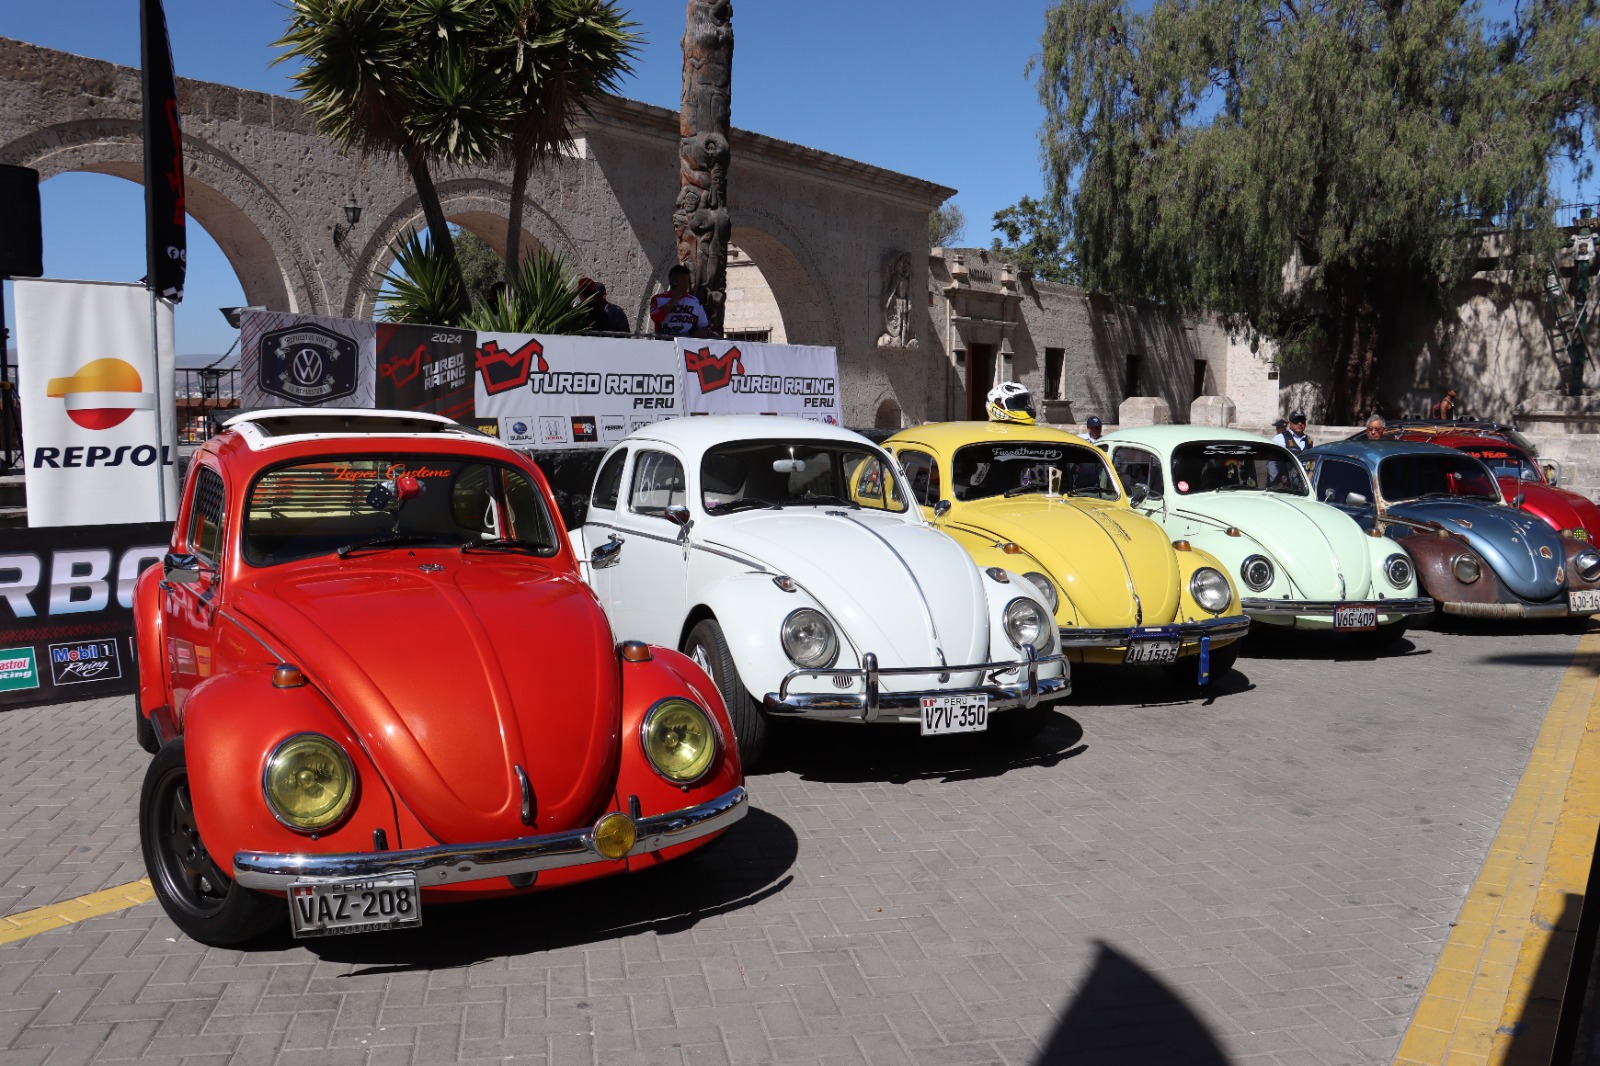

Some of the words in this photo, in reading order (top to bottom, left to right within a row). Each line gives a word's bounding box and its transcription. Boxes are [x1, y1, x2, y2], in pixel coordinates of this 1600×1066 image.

[431, 333, 463, 344] 2024
[423, 353, 464, 377] TURBO
[425, 365, 466, 390] RACING
[530, 372, 601, 394] TURBO
[605, 374, 675, 395] RACING
[731, 374, 782, 394] TURBO
[784, 377, 834, 395] RACING
[633, 398, 674, 409] PERU
[804, 397, 834, 407] PERU
[33, 444, 174, 468] REPSOL
[333, 464, 377, 482] Lopez
[385, 463, 452, 480] Customs
[0, 546, 169, 618] RBO
[1572, 595, 1600, 608] AJO-16
[1337, 612, 1374, 626] V6G-409
[53, 645, 98, 662] Mobil
[0, 659, 27, 670] astrol
[58, 660, 109, 680] Racing
[925, 705, 986, 729] V7V-350
[332, 882, 375, 893] PERU
[297, 888, 412, 924] VAZ-208
